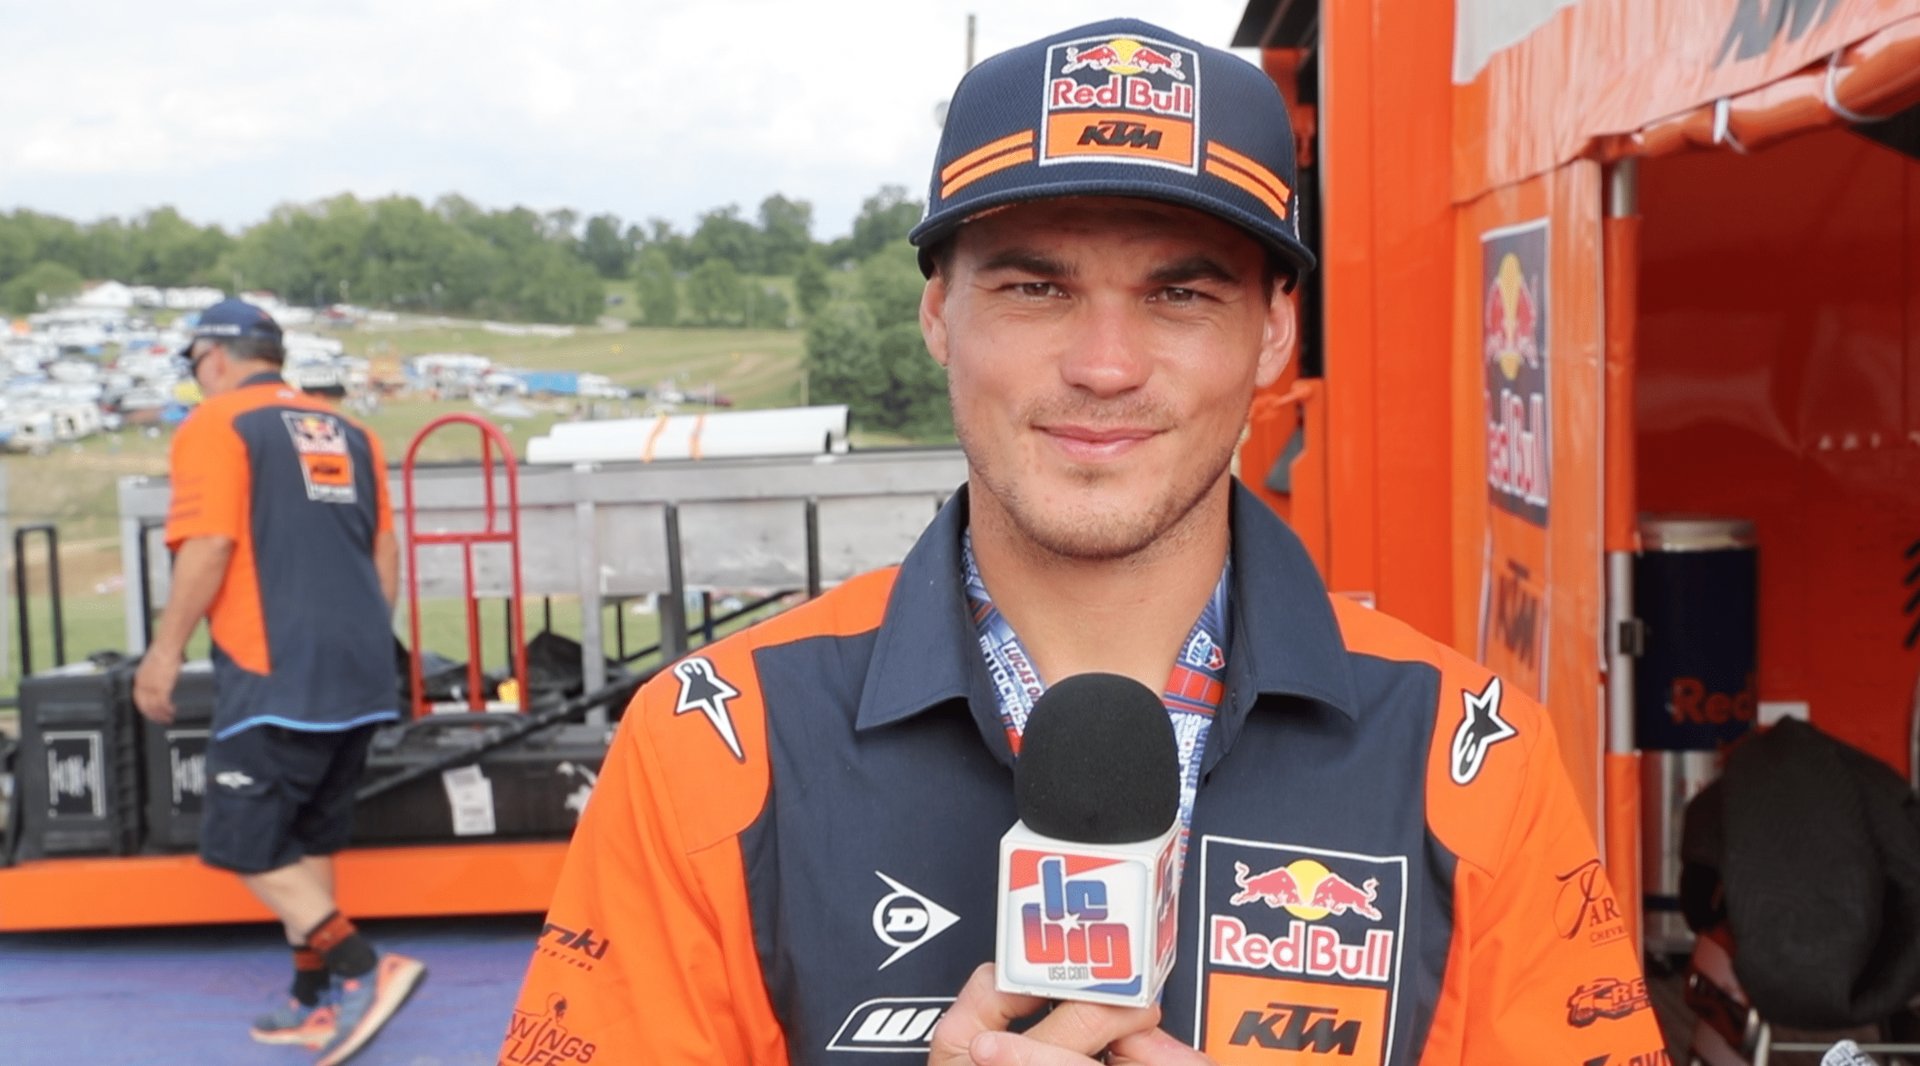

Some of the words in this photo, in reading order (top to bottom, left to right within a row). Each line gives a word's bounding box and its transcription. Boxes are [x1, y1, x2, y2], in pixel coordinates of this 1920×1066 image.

[1050, 74, 1121, 110] Red
[1125, 76, 1193, 118] Bull
[1077, 120, 1163, 150] KTM
[1497, 559, 1537, 670] KTM
[1004, 646, 1036, 684] LUCAS
[1210, 914, 1305, 973] Red
[1306, 924, 1394, 982] Bull
[511, 1011, 597, 1064] WINGS
[851, 1007, 947, 1042] W
[1229, 1002, 1362, 1056] KTM
